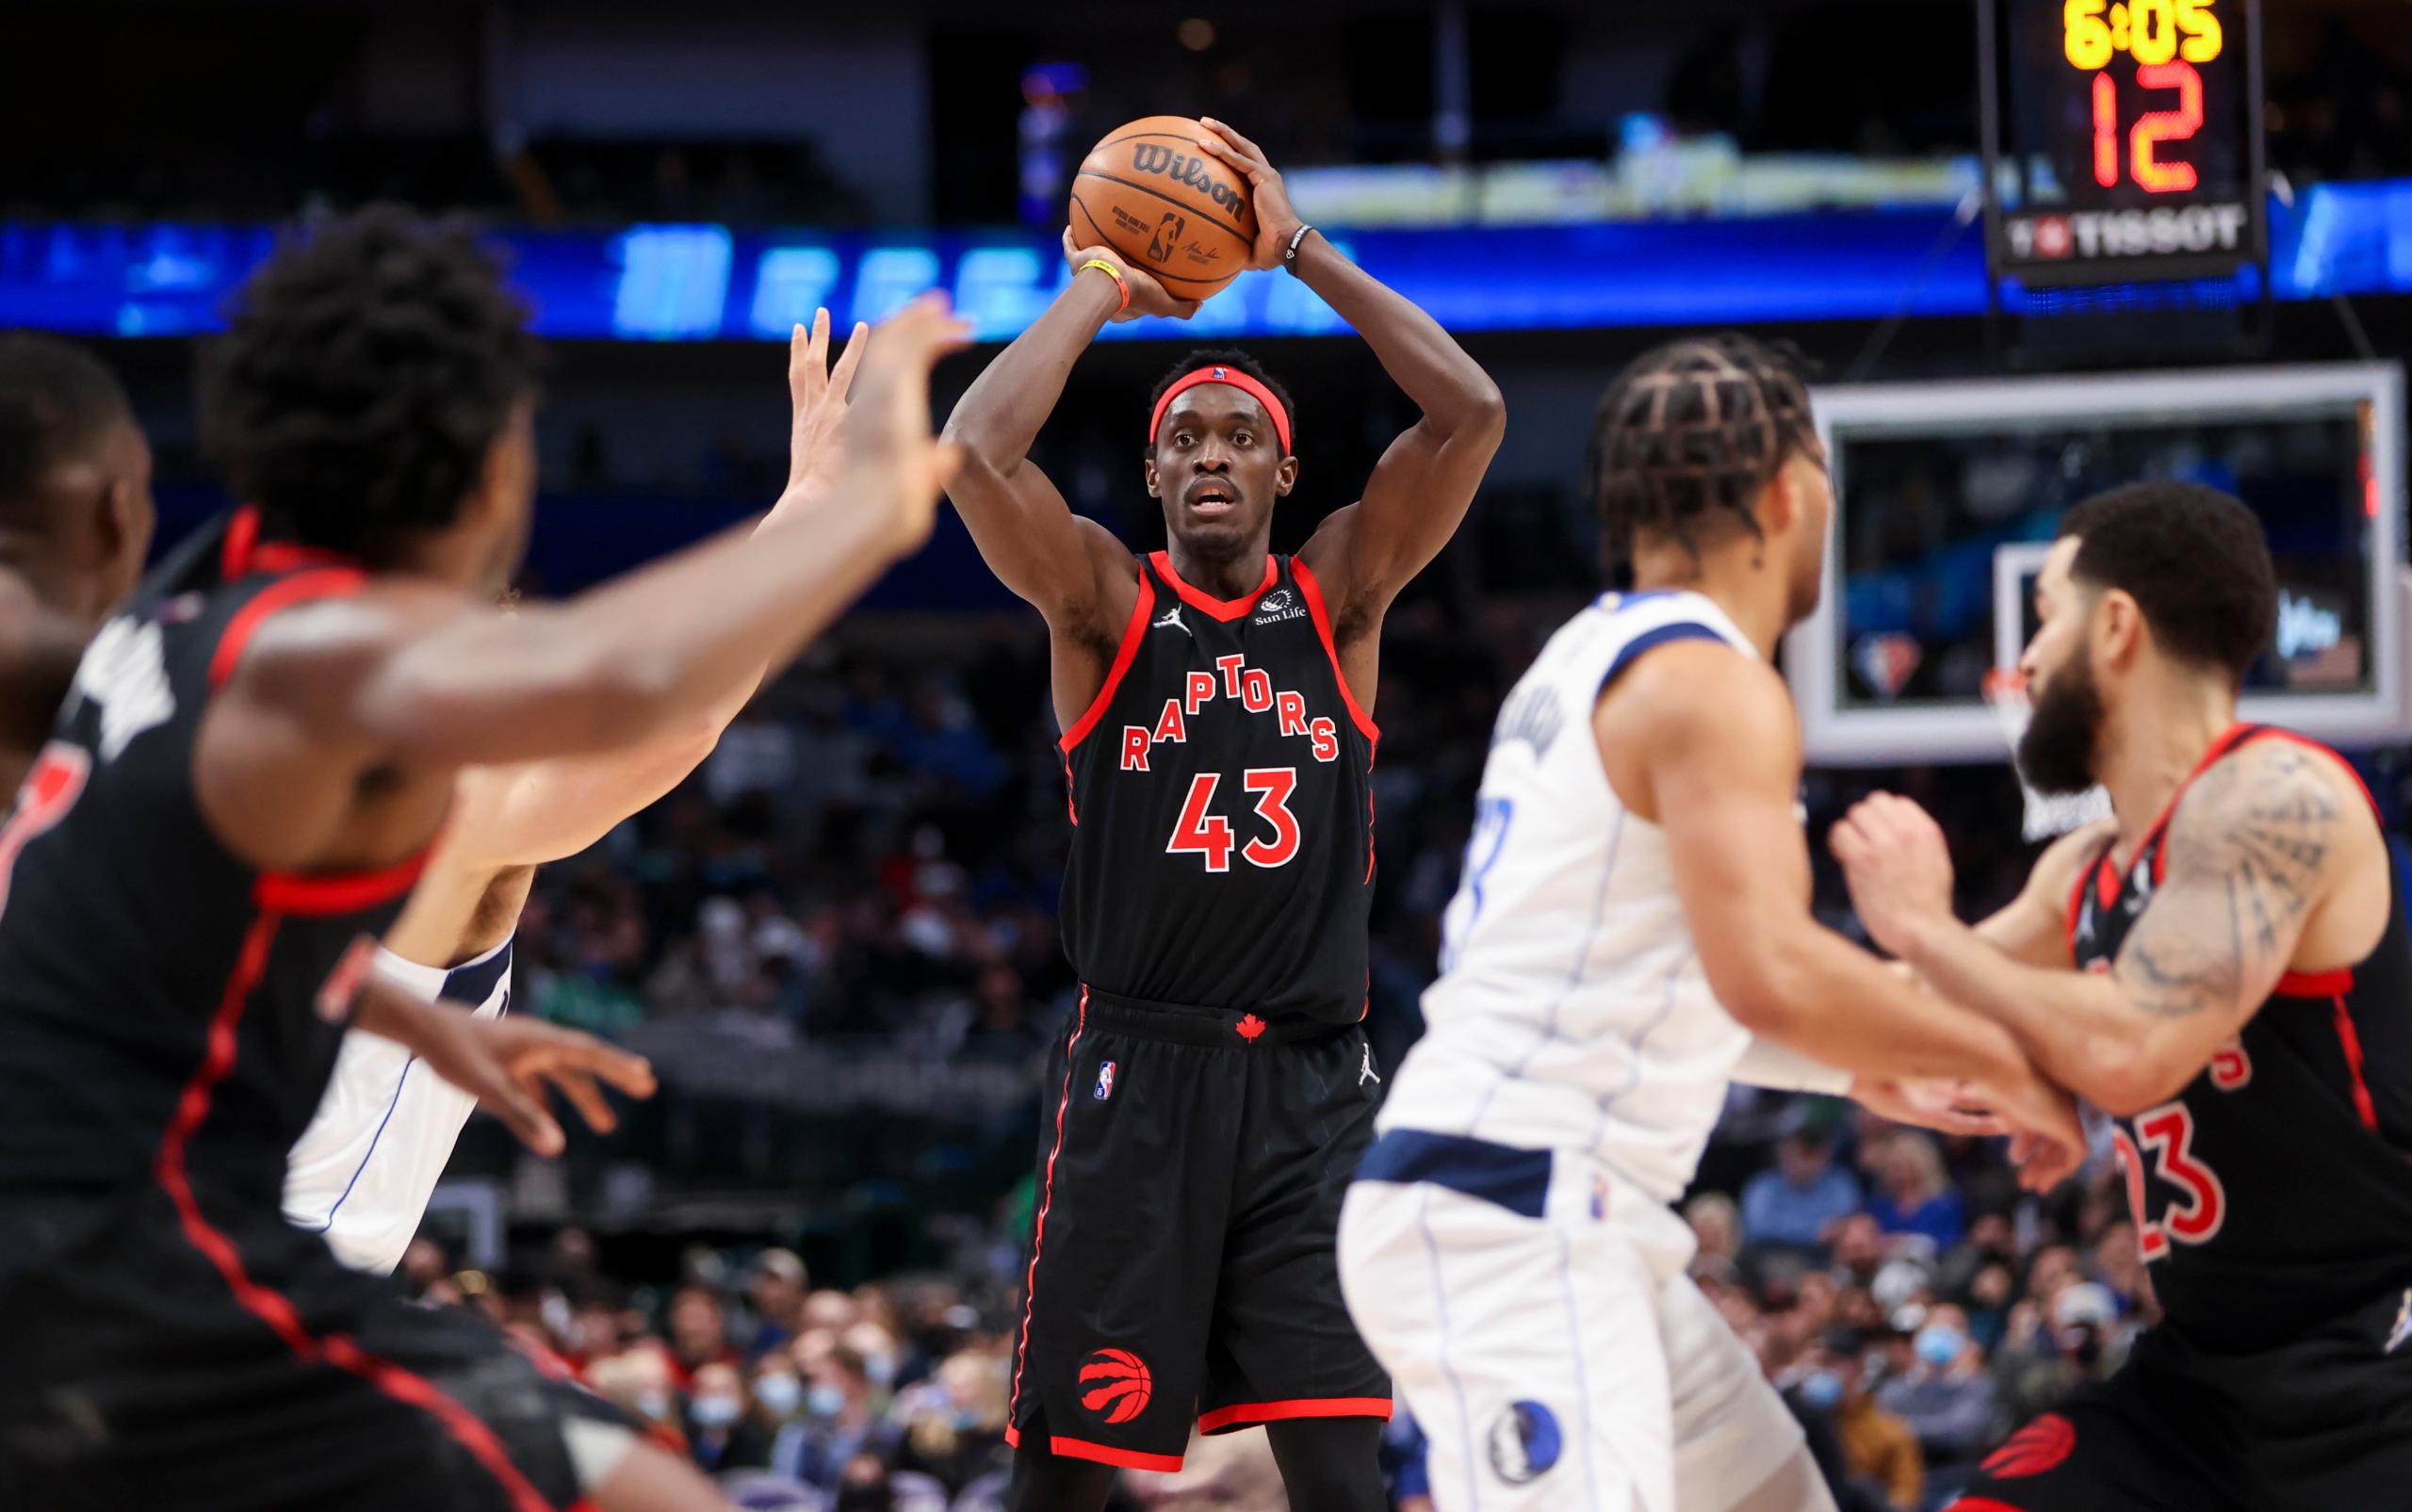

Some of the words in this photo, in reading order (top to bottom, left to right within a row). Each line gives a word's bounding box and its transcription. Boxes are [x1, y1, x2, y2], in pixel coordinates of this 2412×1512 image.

[2063, 0, 2223, 70] 6:05
[2092, 59, 2203, 193] 12
[1133, 143, 1245, 222] Wilson
[2073, 204, 2247, 257] TISSOT
[1254, 614, 1281, 626] Sun
[1281, 606, 1307, 620] Life
[1120, 653, 1339, 772] RAPTORS
[1165, 767, 1301, 872] 43
